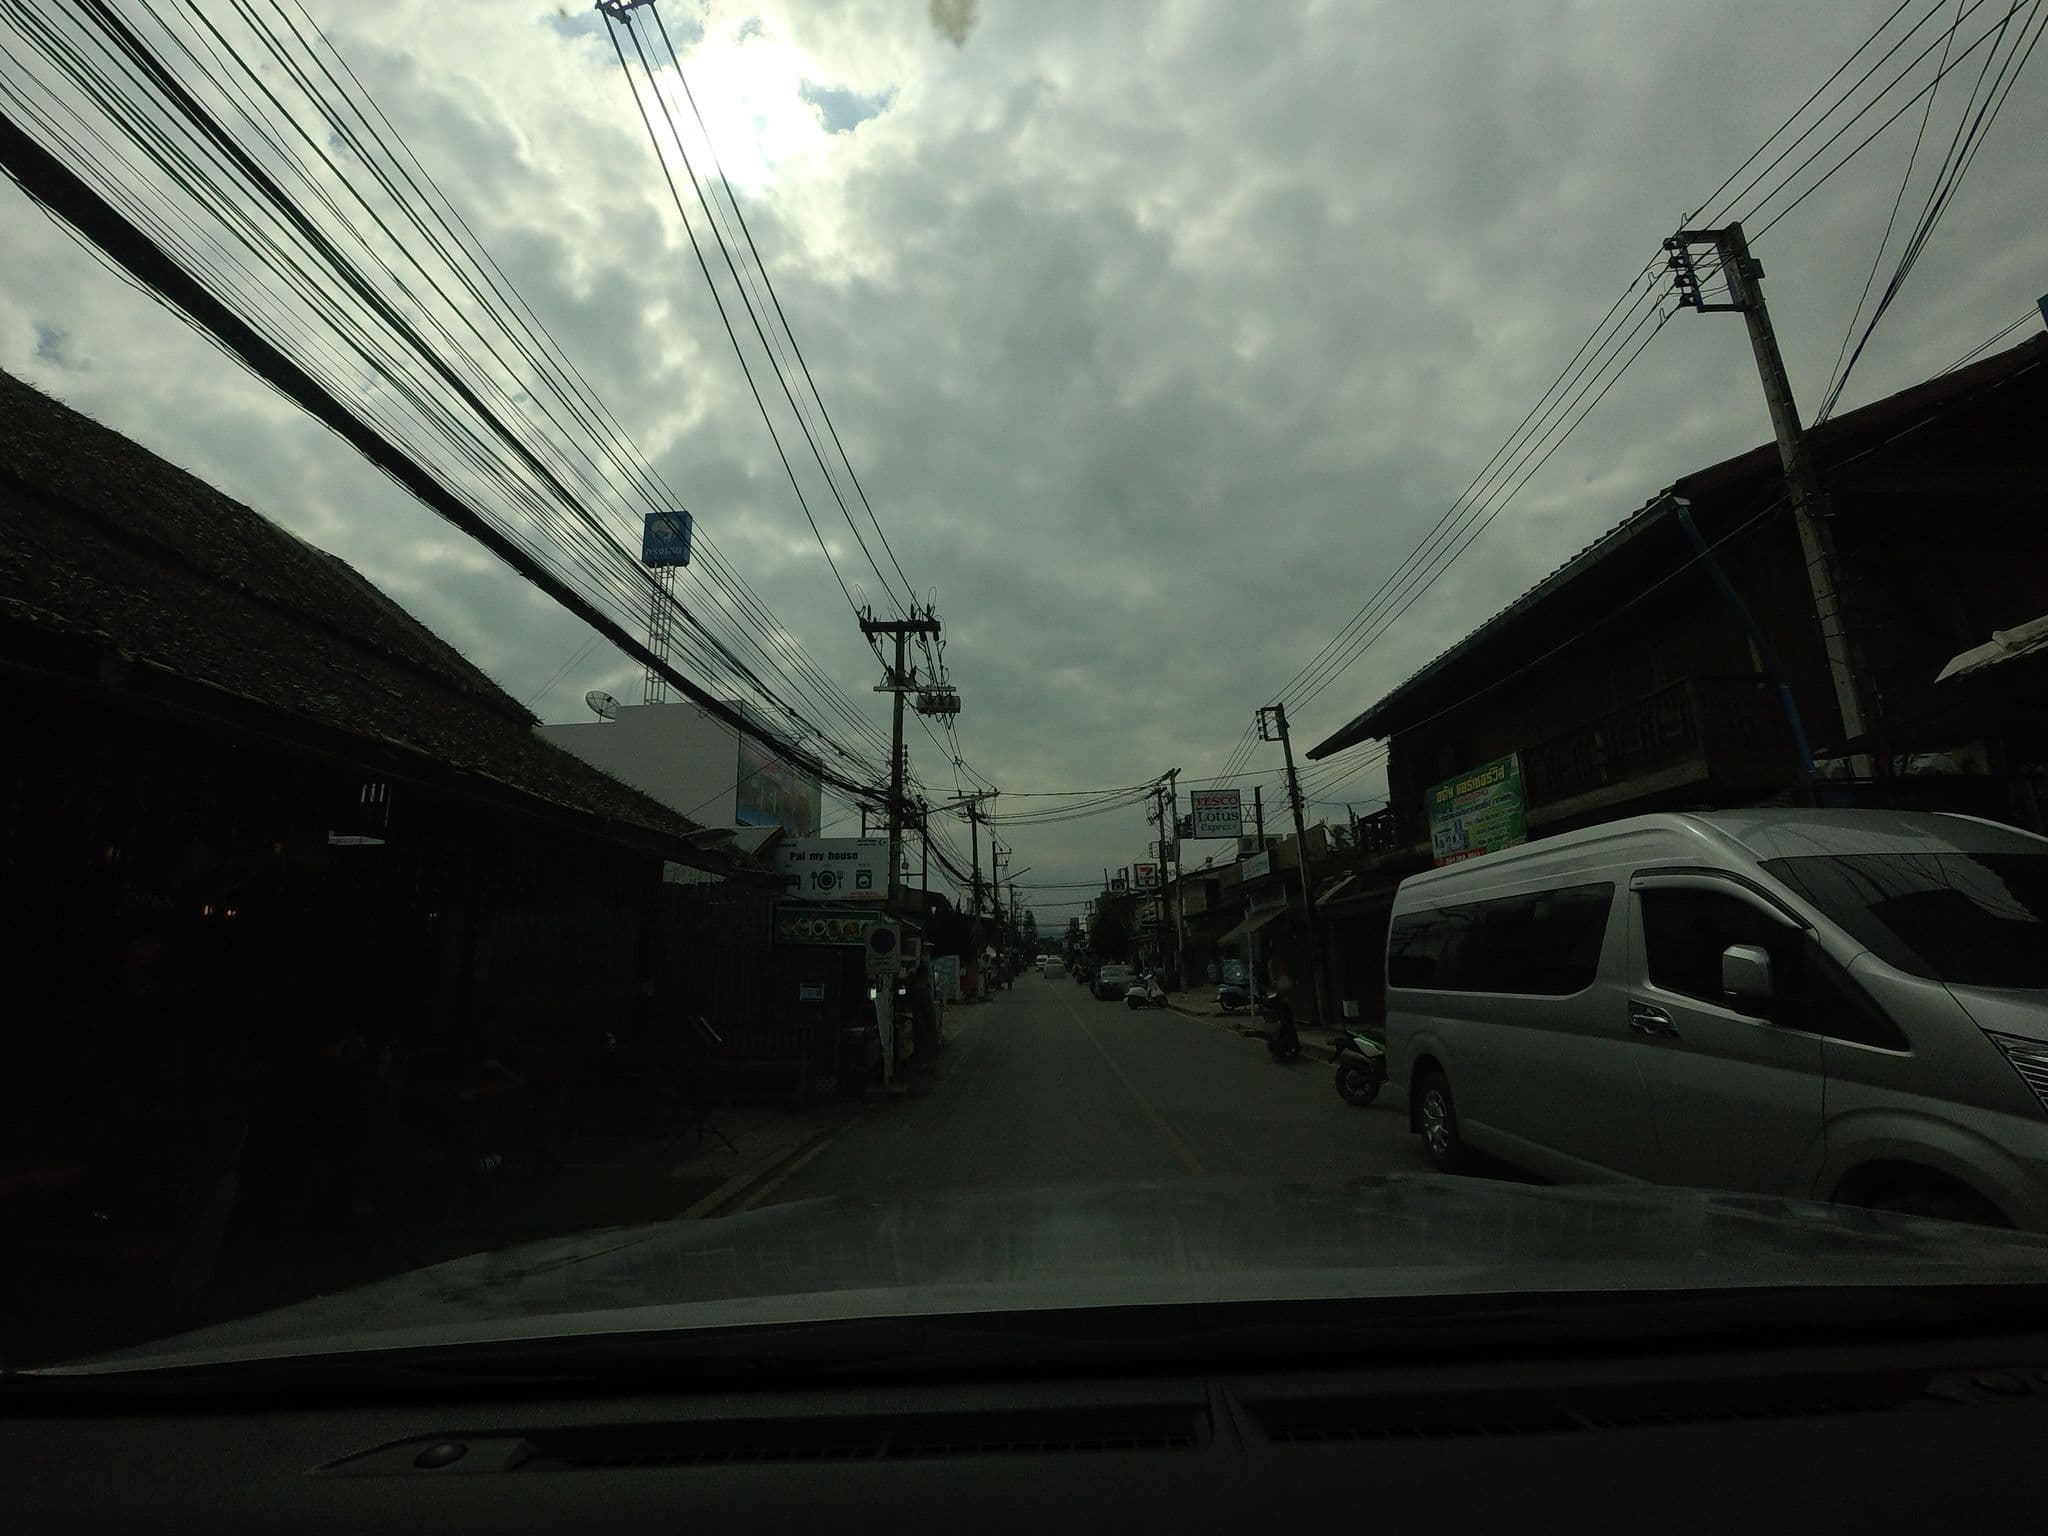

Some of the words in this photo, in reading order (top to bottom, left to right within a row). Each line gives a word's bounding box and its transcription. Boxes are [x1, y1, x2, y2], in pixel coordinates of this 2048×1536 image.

[1196, 796, 1239, 807] TESCO
[1197, 810, 1239, 822] Lotus
[1200, 822, 1238, 833] Express
[809, 852, 825, 862] my
[828, 851, 858, 861] house
